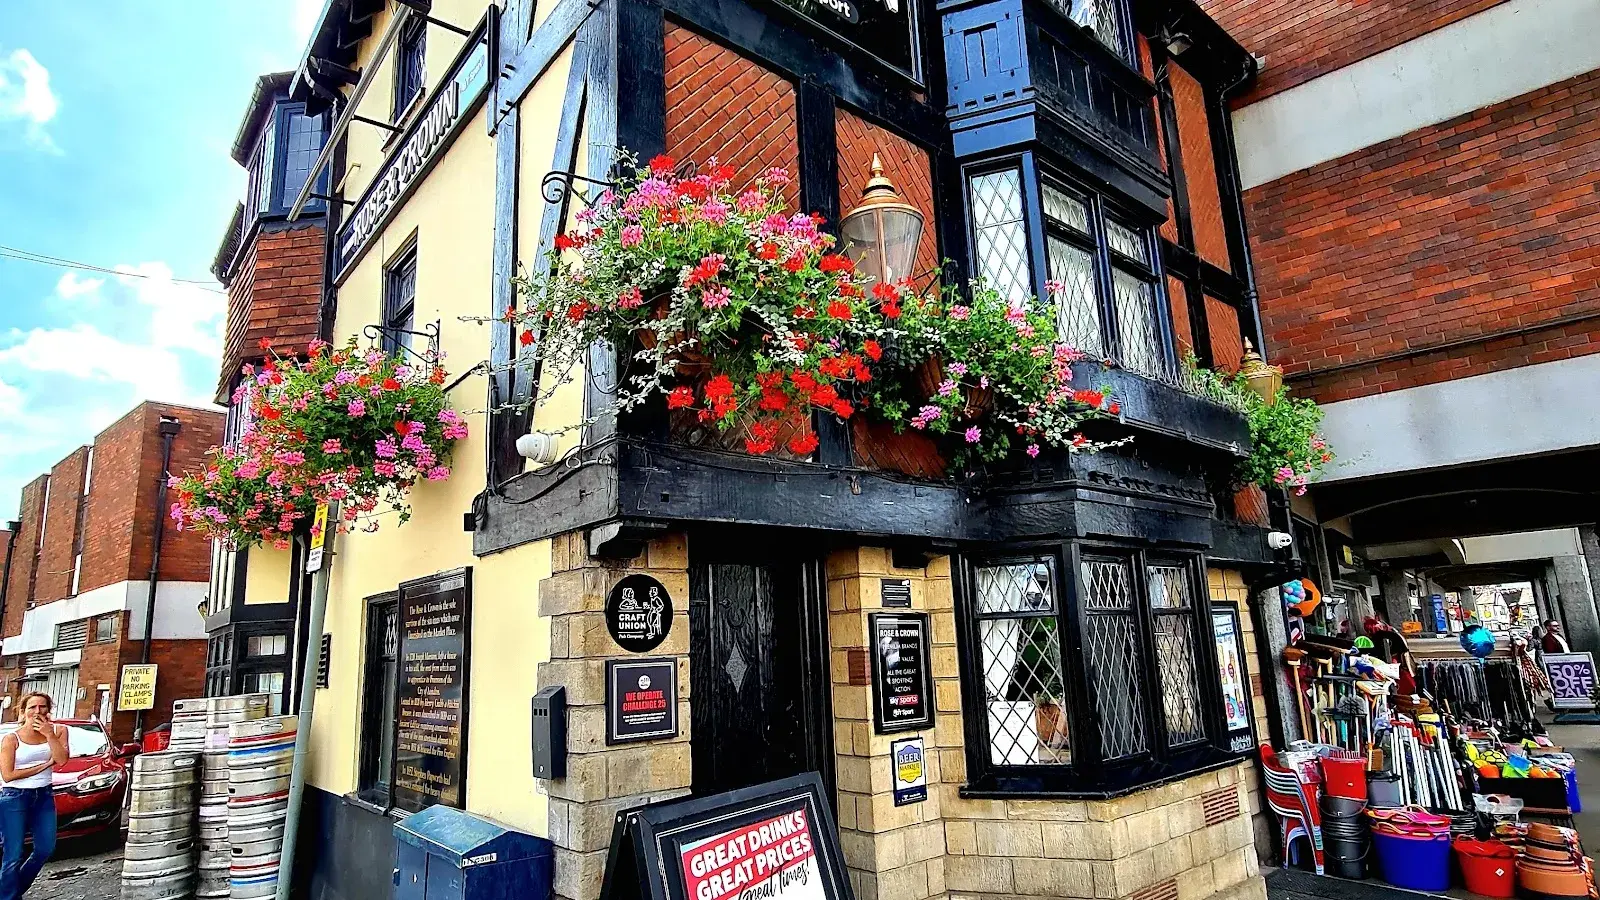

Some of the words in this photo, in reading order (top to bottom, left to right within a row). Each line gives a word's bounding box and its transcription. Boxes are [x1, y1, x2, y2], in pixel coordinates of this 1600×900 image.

[351, 178, 389, 248] ROSE
[388, 165, 401, 202] &
[399, 79, 460, 185] CROWN
[618, 613, 646, 622] CRAFT
[618, 622, 647, 630] UNION
[879, 629, 895, 638] ROSE
[895, 629, 900, 638] &
[900, 629, 919, 638] CROWN
[124, 667, 151, 676] PRIVATE
[1548, 664, 1591, 680] 50%
[131, 675, 141, 683] NO
[1552, 676, 1593, 691] OFF
[124, 690, 153, 698] CLAMPS
[625, 692, 637, 701] WE
[636, 690, 664, 701] OPERATE
[622, 701, 658, 712] CHALLENGE
[657, 699, 667, 708] 25
[900, 696, 918, 705] sports
[899, 752, 920, 764] BEER
[690, 834, 748, 878] GREAT
[748, 810, 806, 852] DRINKS
[696, 858, 754, 900] GREAT
[755, 832, 812, 876] PRICES
